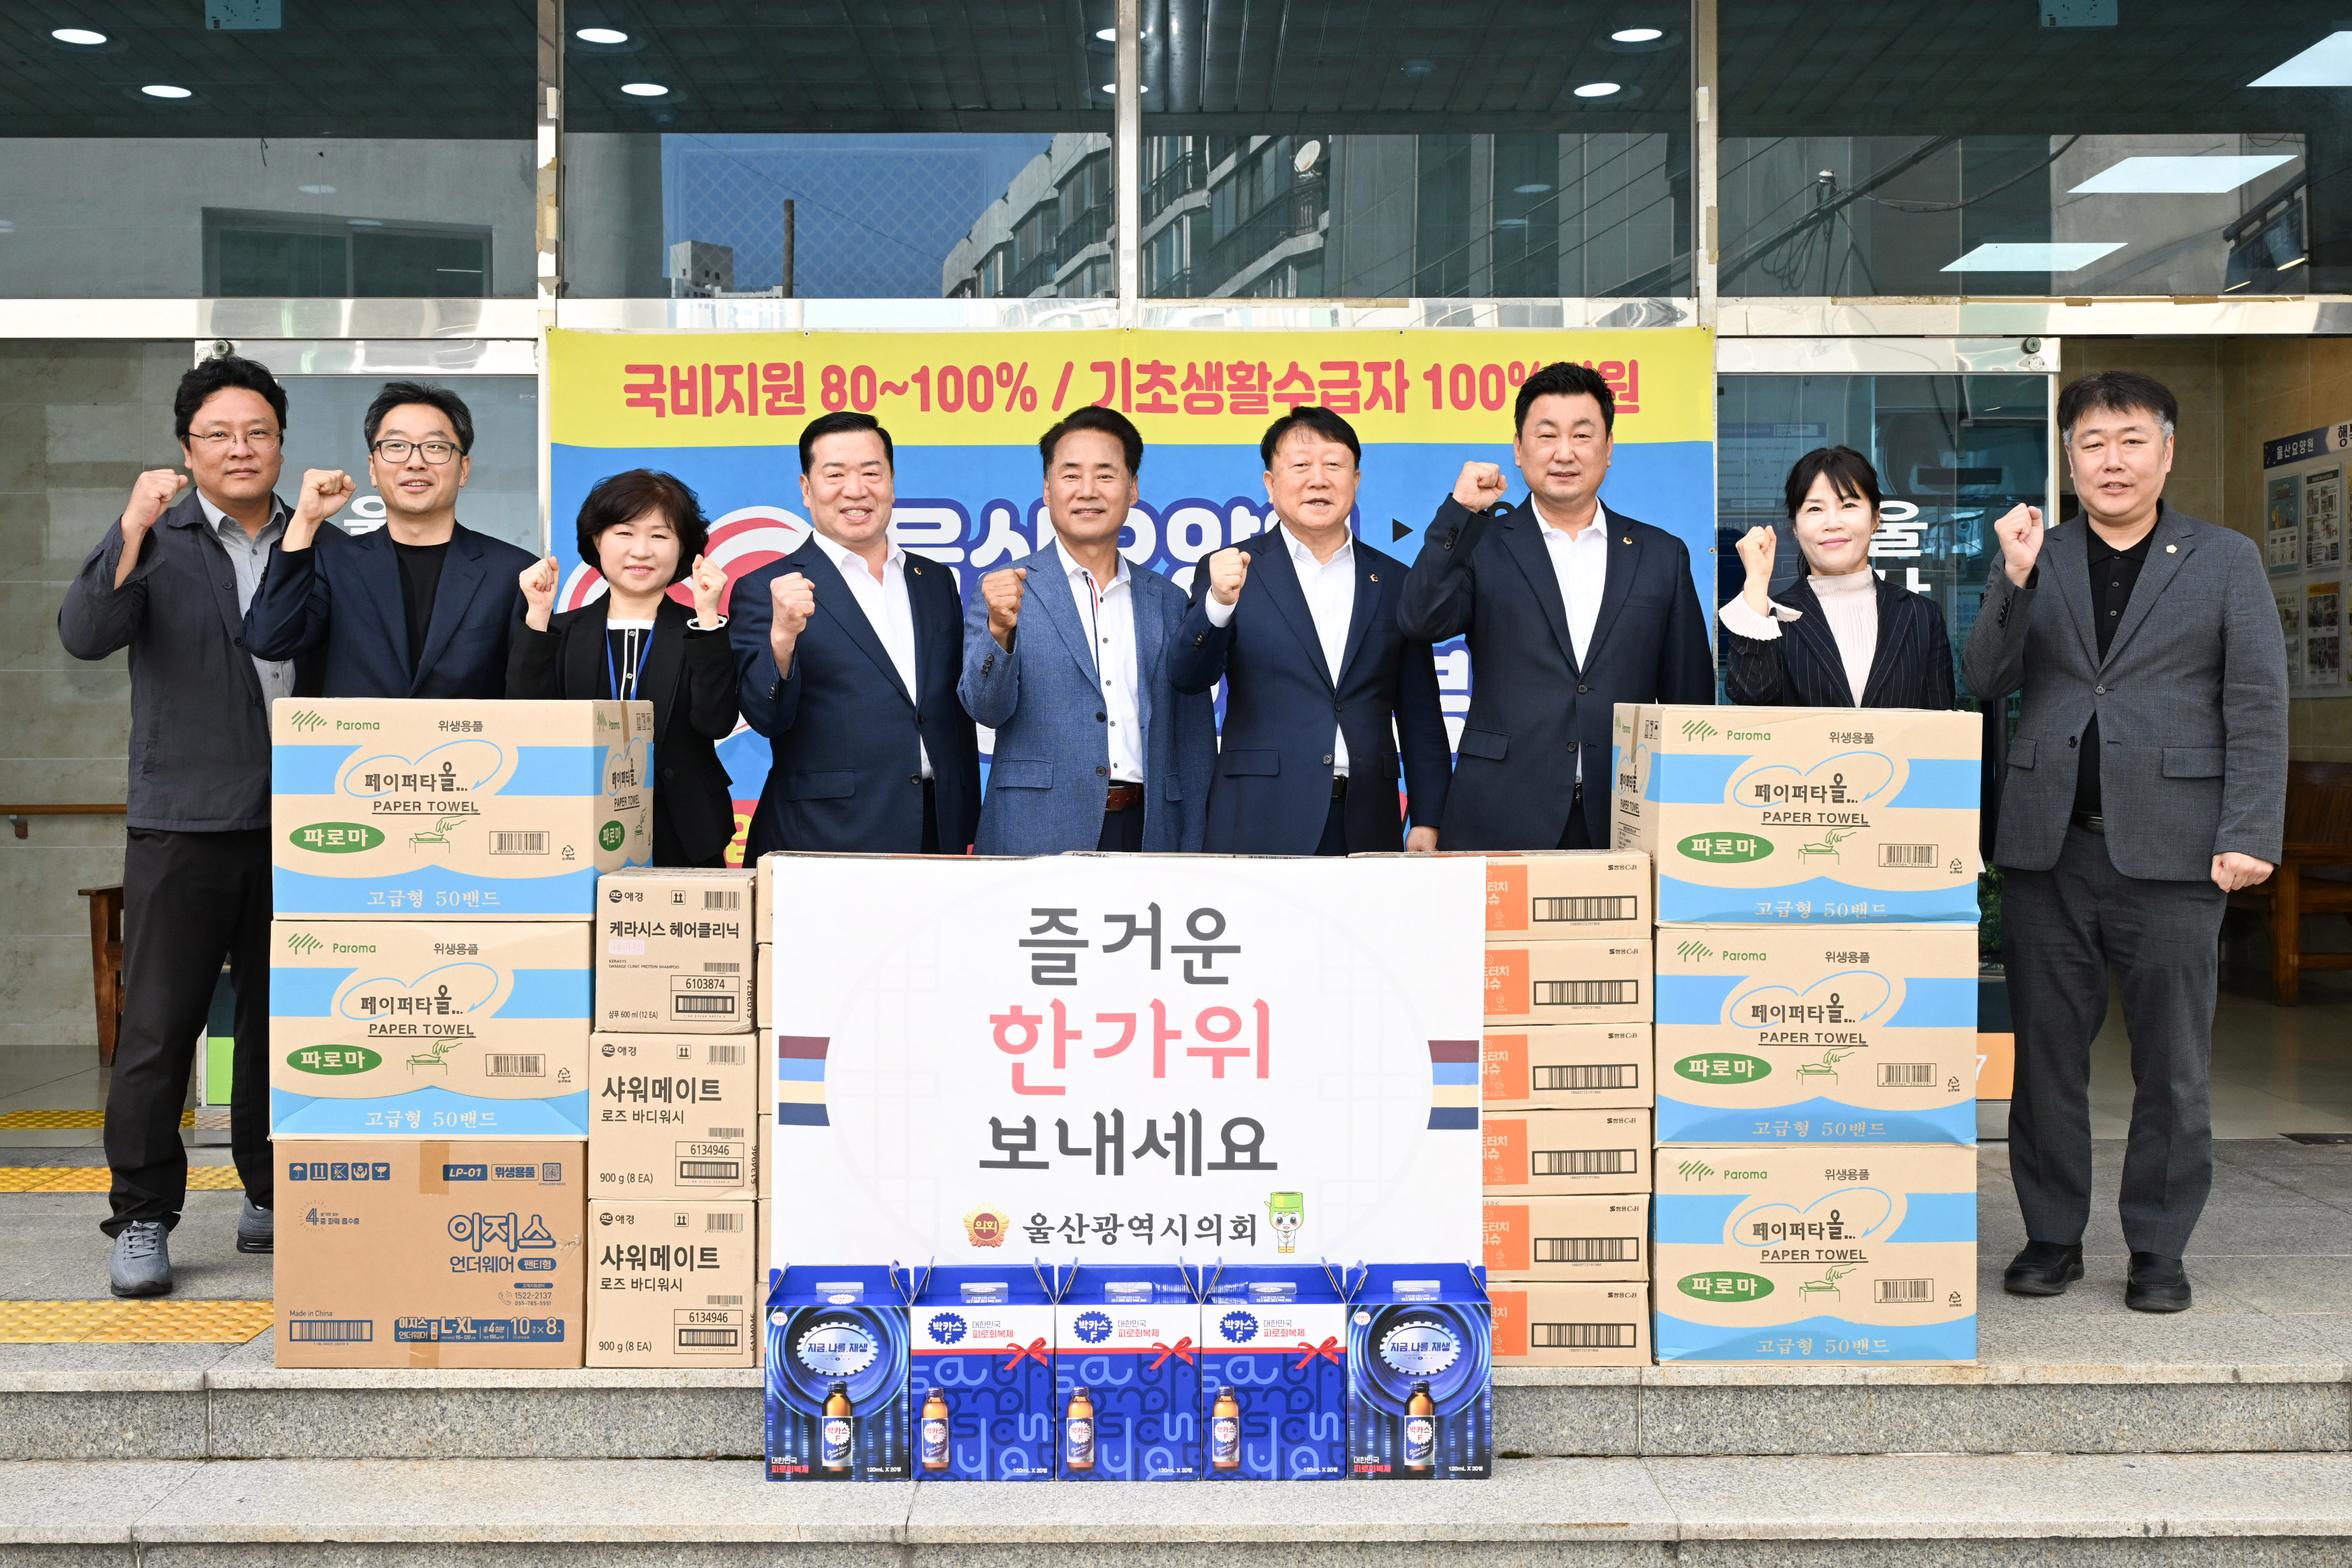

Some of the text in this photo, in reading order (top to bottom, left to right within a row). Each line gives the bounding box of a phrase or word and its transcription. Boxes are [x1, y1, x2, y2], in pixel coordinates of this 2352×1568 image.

[624, 361, 806, 417] 국비지원
[822, 361, 1037, 412] 80~100%
[1089, 358, 1409, 415] 기초생활수급자
[2338, 423, 2352, 448] 행
[2277, 437, 2314, 461] 울산요양원
[337, 720, 380, 731] Paroma
[438, 720, 483, 732] 위생용품
[1727, 730, 1770, 741] Paroma
[1829, 731, 1875, 743] 위생용품
[374, 801, 479, 812] PAPER TOWEL
[614, 795, 640, 808] PAPER TOWEL
[1620, 799, 1640, 813] PAPER TOWEL
[1762, 811, 1868, 824] PAPER TOWEL
[304, 829, 368, 846] 파로마
[603, 827, 621, 845] 파로마
[1691, 838, 1757, 857] 파로마
[367, 890, 501, 907] 고급형 50밴드
[625, 892, 643, 902] 애경
[1754, 901, 1888, 919] 고급형 50밴드
[610, 921, 739, 939] 케라시스 헤어클리닉
[333, 943, 376, 953] Paroma
[433, 943, 478, 955] 위생용품
[1019, 902, 1241, 986] 즐거운
[1723, 951, 1766, 961] Paroma
[1824, 951, 1870, 963] 위생용품
[685, 979, 725, 990] 6103874
[369, 1024, 474, 1035] PAPER TOWEL
[1760, 1032, 1866, 1044] PAPER TOWEL
[617, 1046, 636, 1056] 애경
[990, 998, 1270, 1095] 한가위
[301, 1051, 365, 1068] 파로마
[1689, 1059, 1754, 1077] 파로마
[601, 1076, 722, 1103] 샤워메이트
[364, 1111, 497, 1128] 고급형 50밴드
[601, 1110, 683, 1124] 로즈 바디워시
[1752, 1121, 1886, 1138] 고급형 50밴드
[979, 1109, 1277, 1177] 보내세요
[690, 1145, 729, 1155] 6134946
[449, 1168, 481, 1177] LP-01
[495, 1166, 535, 1179] 위생용품
[600, 1173, 653, 1184] 900 g (8 EA)
[1724, 1169, 1767, 1180] Paroma
[1824, 1168, 1870, 1181] 위생용품
[615, 1215, 634, 1224] 애경
[447, 1212, 556, 1252] 이지스
[975, 1221, 997, 1233] 의회
[1023, 1213, 1256, 1246] 울산광역시의회
[600, 1244, 720, 1271] 샤워메이트
[1761, 1249, 1866, 1260] PAPER TOWEL
[450, 1256, 551, 1273] 언더웨어 팬티형
[600, 1277, 682, 1292] 로즈 바디워시
[1692, 1278, 1757, 1296] 파로마
[399, 1317, 428, 1329] 이지스
[689, 1312, 728, 1323] 6134946
[441, 1317, 477, 1334] L-XL
[933, 1321, 962, 1332] 박카스
[1079, 1320, 1108, 1331] 박카스
[1224, 1319, 1254, 1330] 박카스
[399, 1331, 428, 1340] 언더웨어
[945, 1333, 951, 1341] F
[972, 1330, 1013, 1338] 피로회복제
[1090, 1331, 1097, 1340] F
[1118, 1329, 1159, 1338] 피로회복제
[1236, 1331, 1243, 1340] F
[1264, 1329, 1305, 1337] 피로회복제
[599, 1341, 652, 1352] 900 g (8 EA)
[1756, 1338, 1890, 1355] 고급형 50밴드
